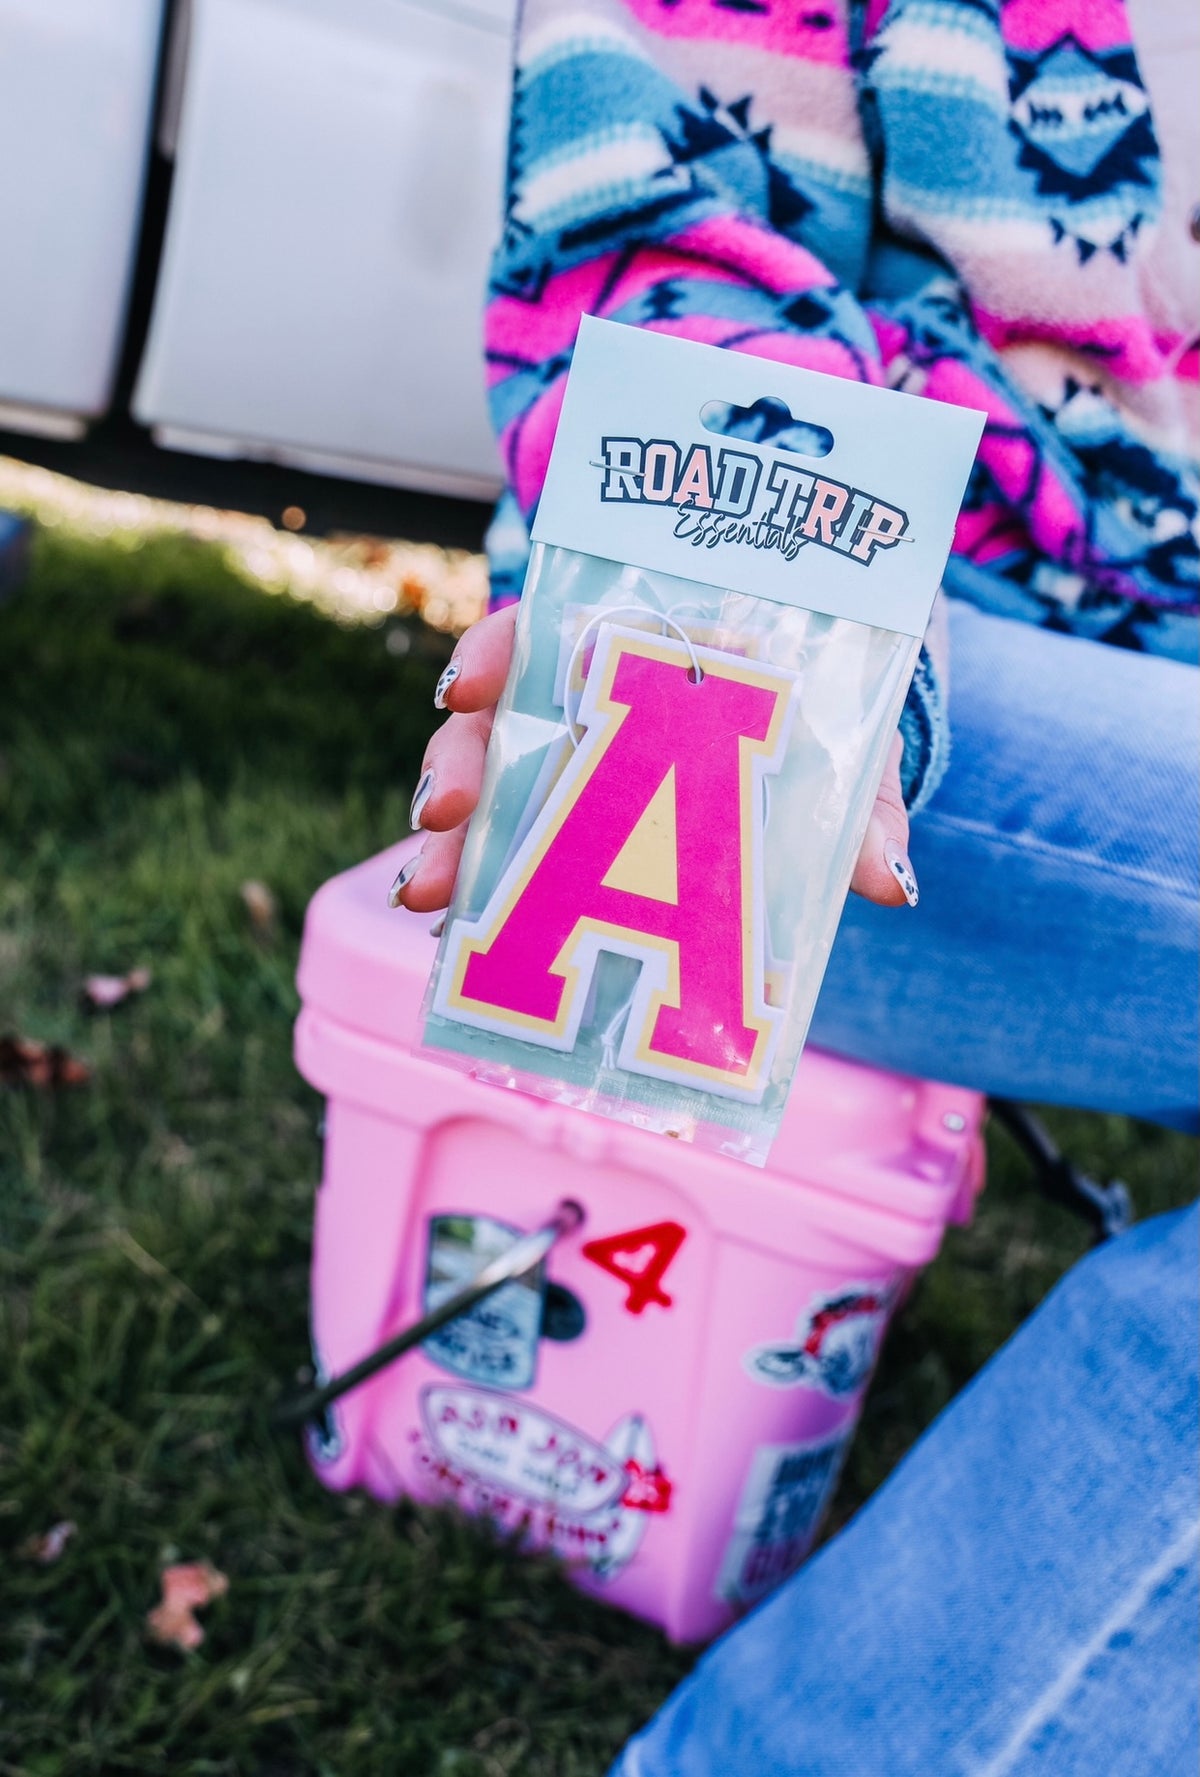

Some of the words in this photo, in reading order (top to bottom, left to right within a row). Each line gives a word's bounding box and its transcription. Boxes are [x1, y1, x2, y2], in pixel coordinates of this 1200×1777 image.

[601, 436, 763, 518] ROAD
[767, 461, 910, 567] TRIP
[460, 651, 779, 1076] A
